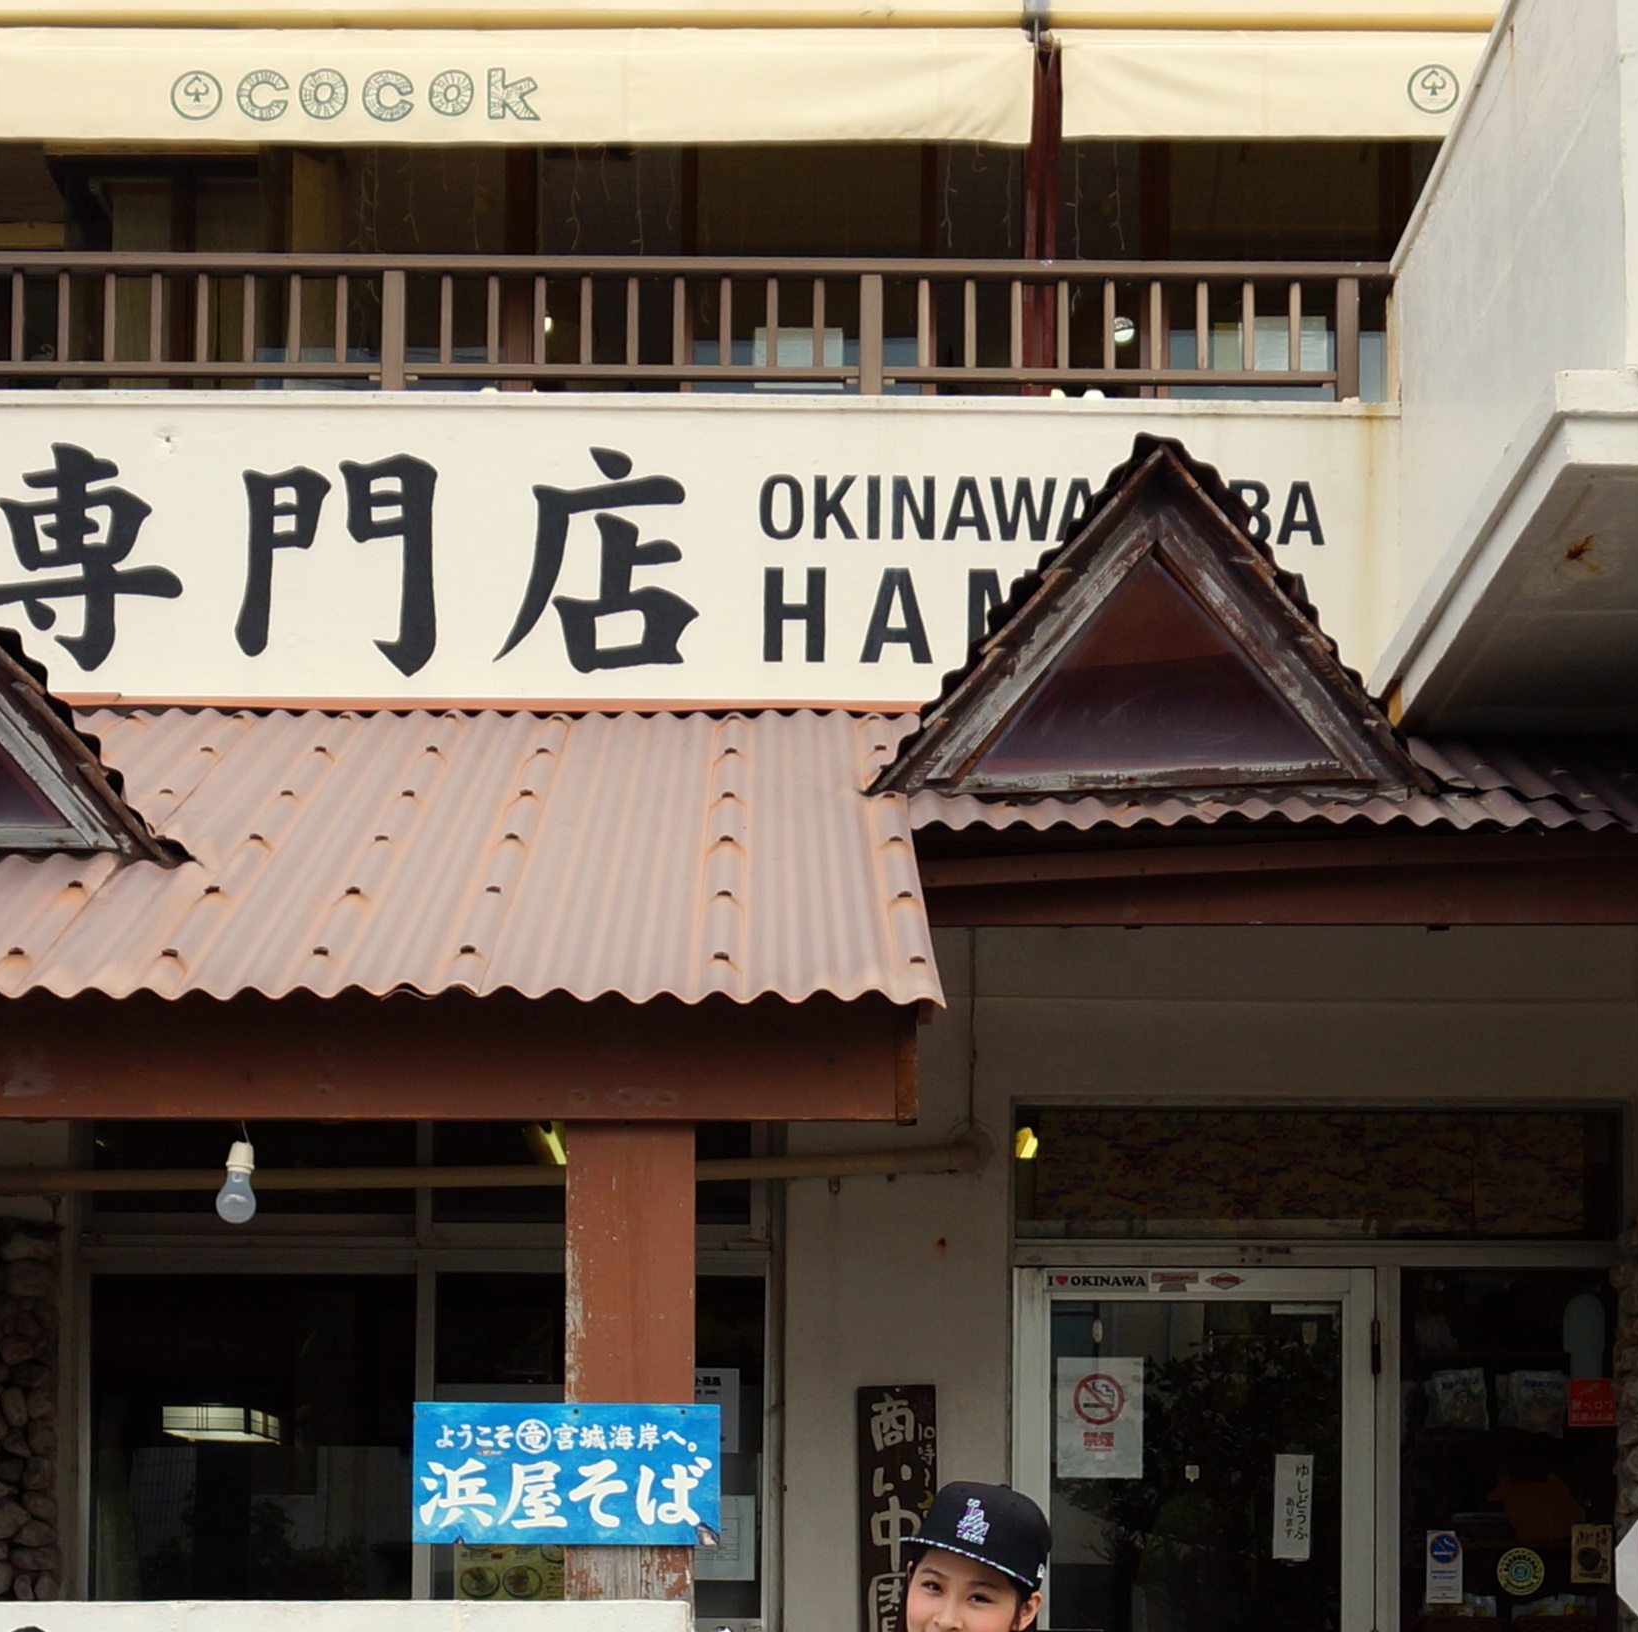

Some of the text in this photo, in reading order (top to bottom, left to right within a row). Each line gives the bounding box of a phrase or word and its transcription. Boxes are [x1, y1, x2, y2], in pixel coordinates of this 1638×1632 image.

[1071, 1275, 1146, 1287] OKINAWA
[419, 1456, 713, 1529] 浜屋そば
